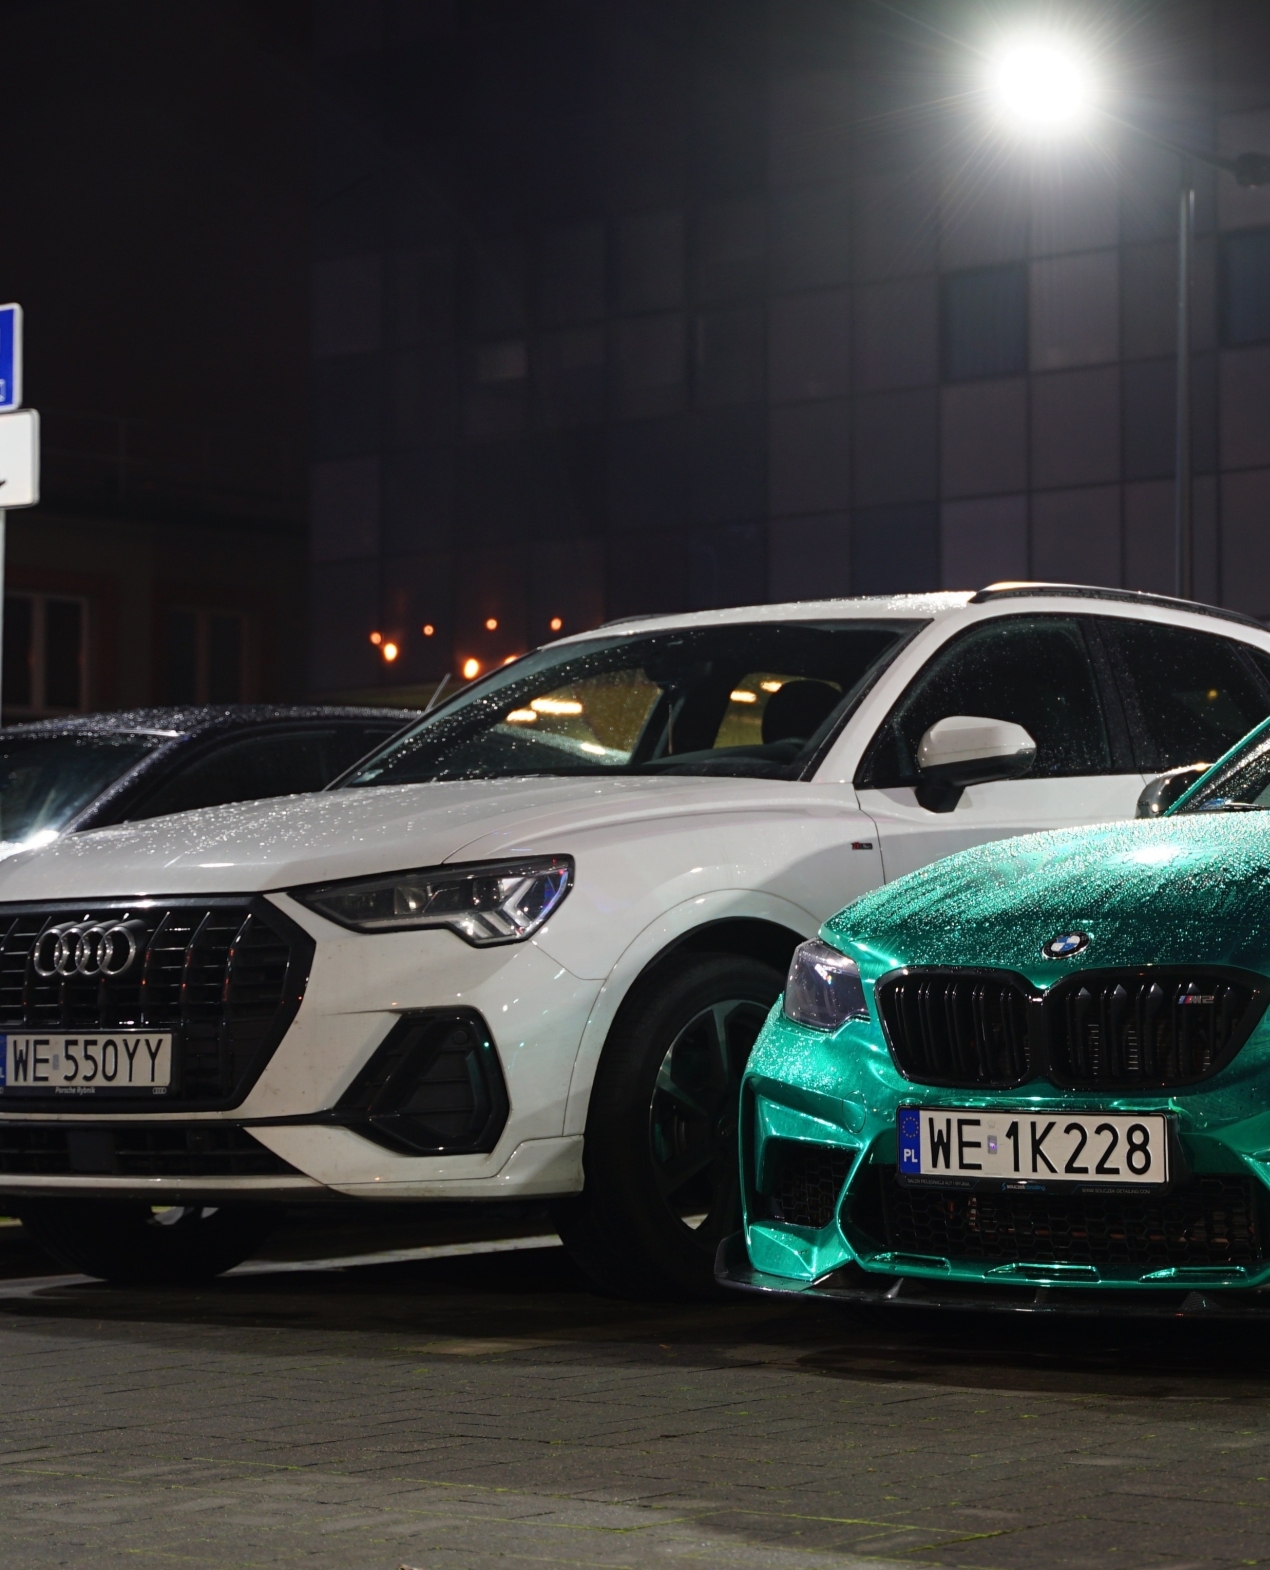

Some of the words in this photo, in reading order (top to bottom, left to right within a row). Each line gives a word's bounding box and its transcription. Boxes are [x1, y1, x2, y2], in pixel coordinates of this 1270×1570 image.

[13, 1039, 50, 1082] WE
[63, 1038, 163, 1082] 550YY
[903, 1148, 918, 1163] PL
[928, 1117, 982, 1170] WE
[1005, 1120, 1151, 1175] 1K228
